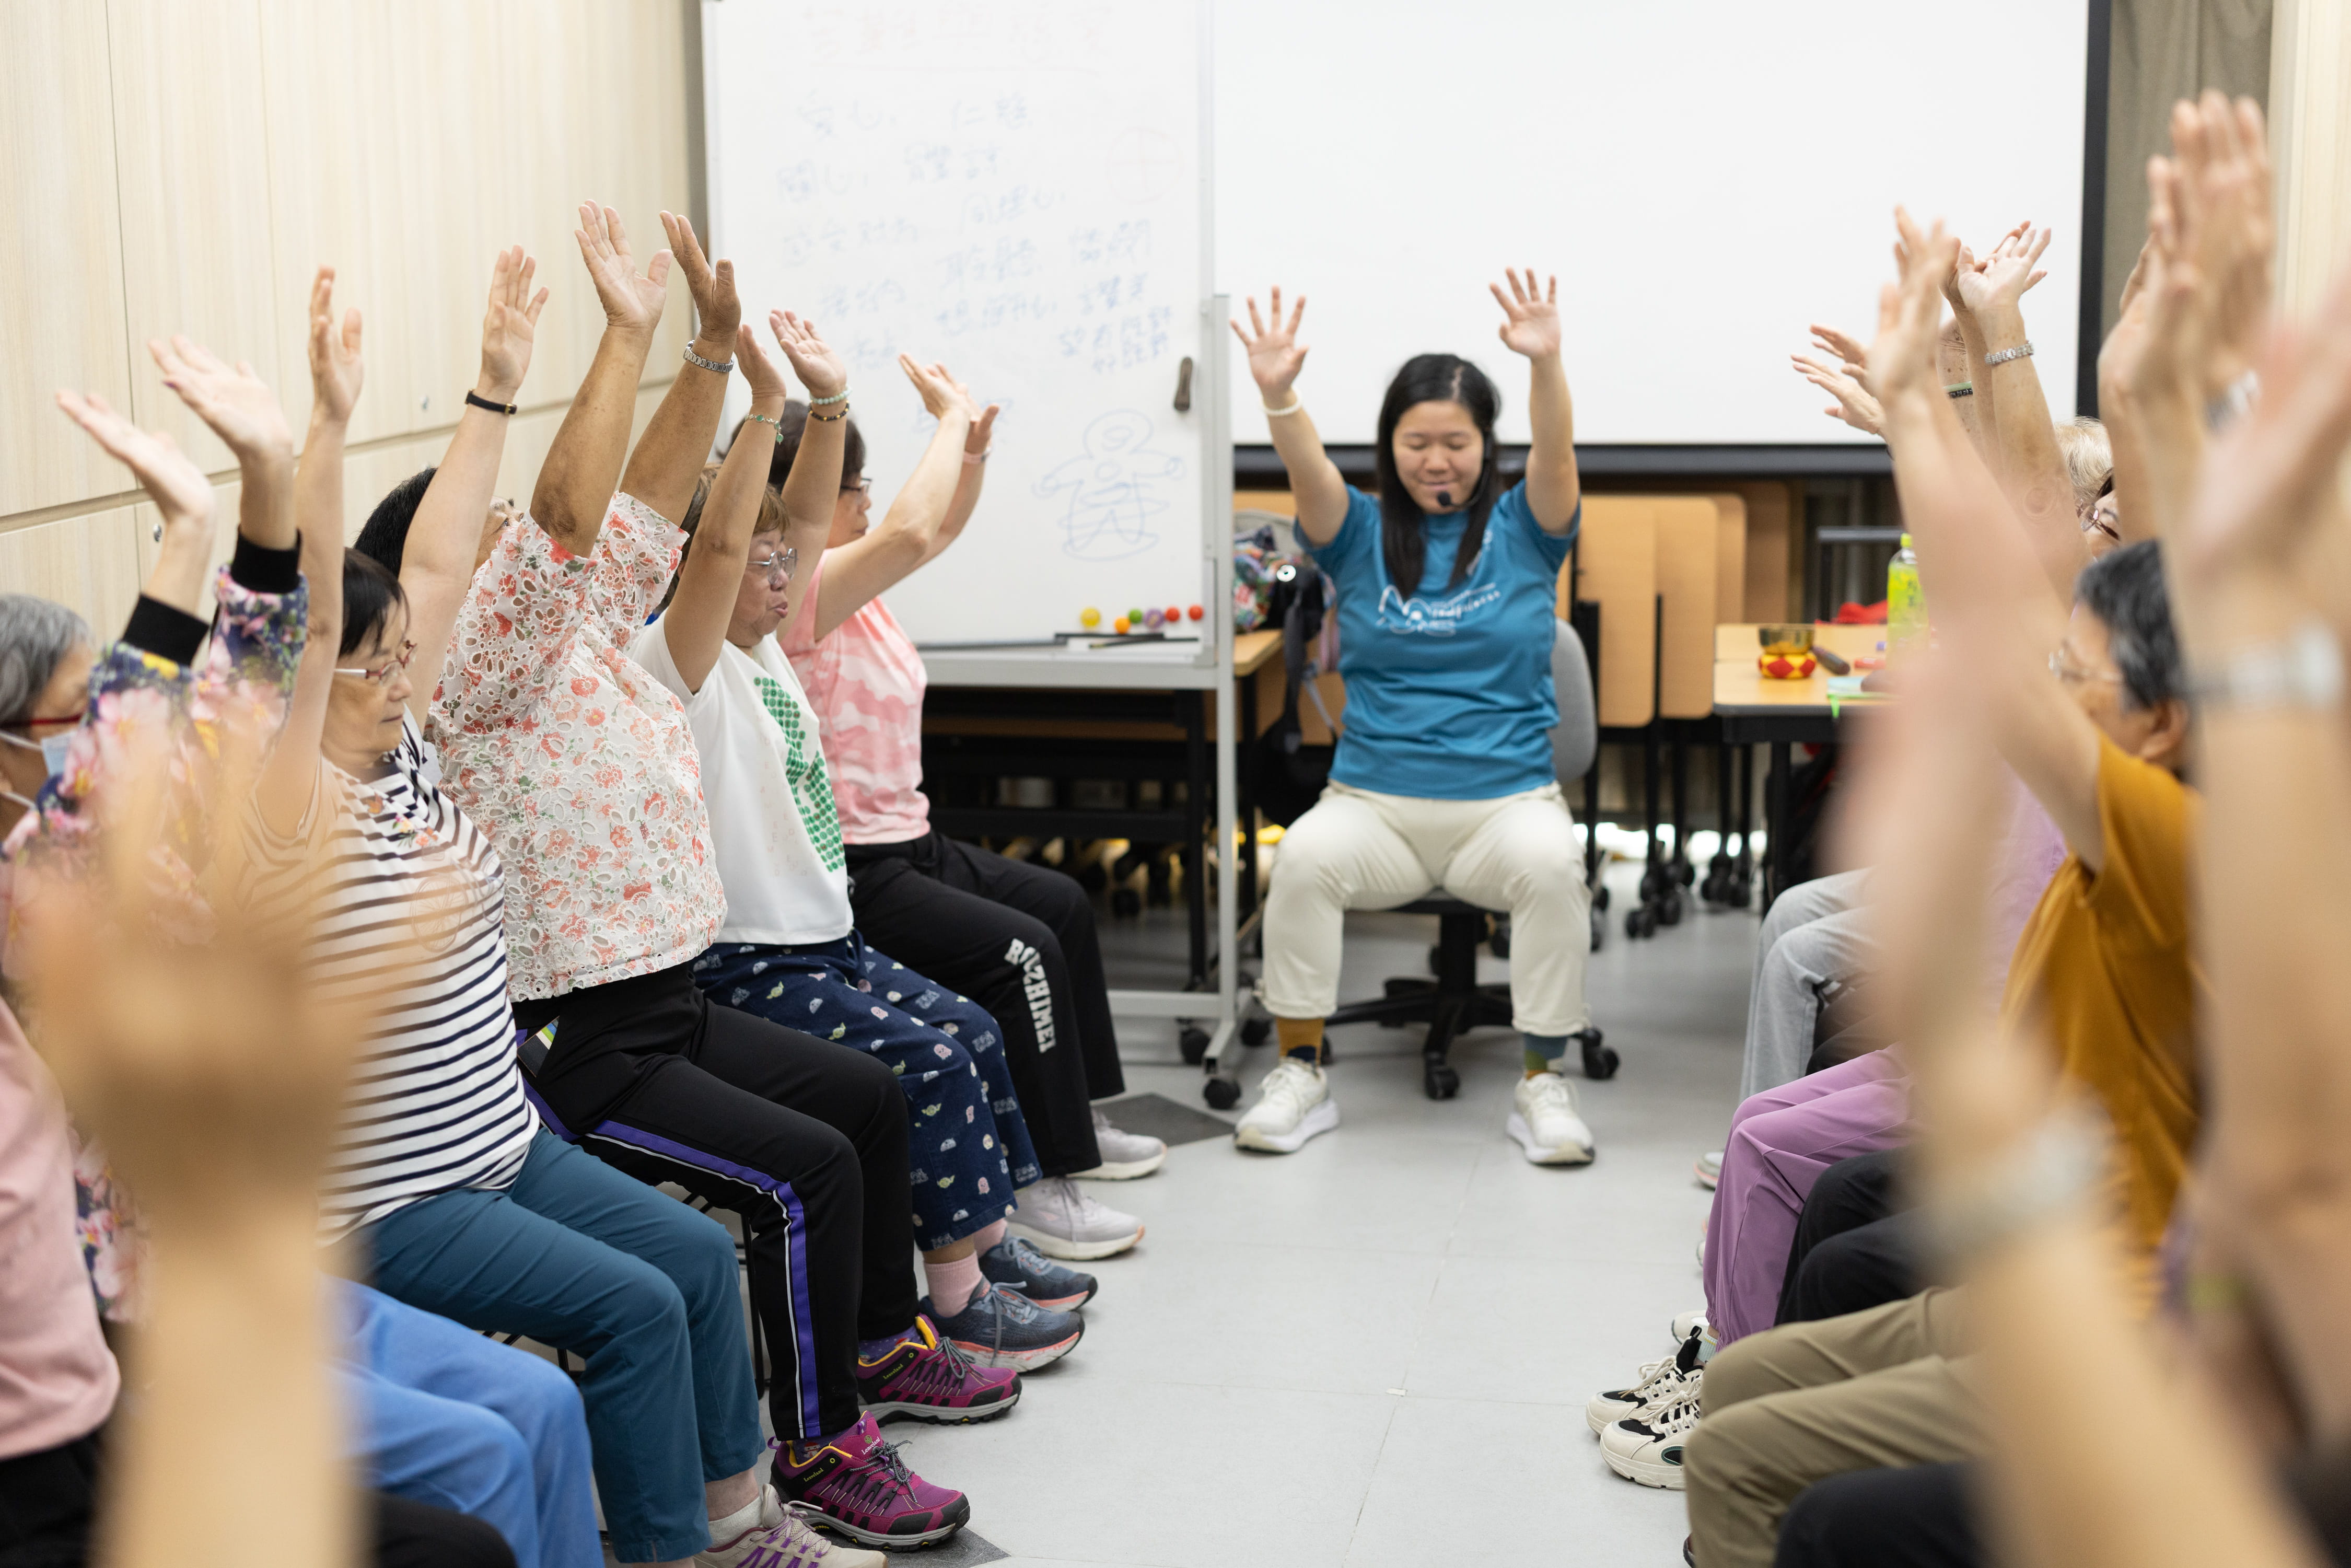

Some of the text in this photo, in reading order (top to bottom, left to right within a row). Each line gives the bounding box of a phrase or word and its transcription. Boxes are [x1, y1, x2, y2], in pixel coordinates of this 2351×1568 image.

[882, 1363, 904, 1379] Leaveland
[861, 1436, 881, 1455] Leaveland
[803, 1467, 824, 1482] Leaveland
